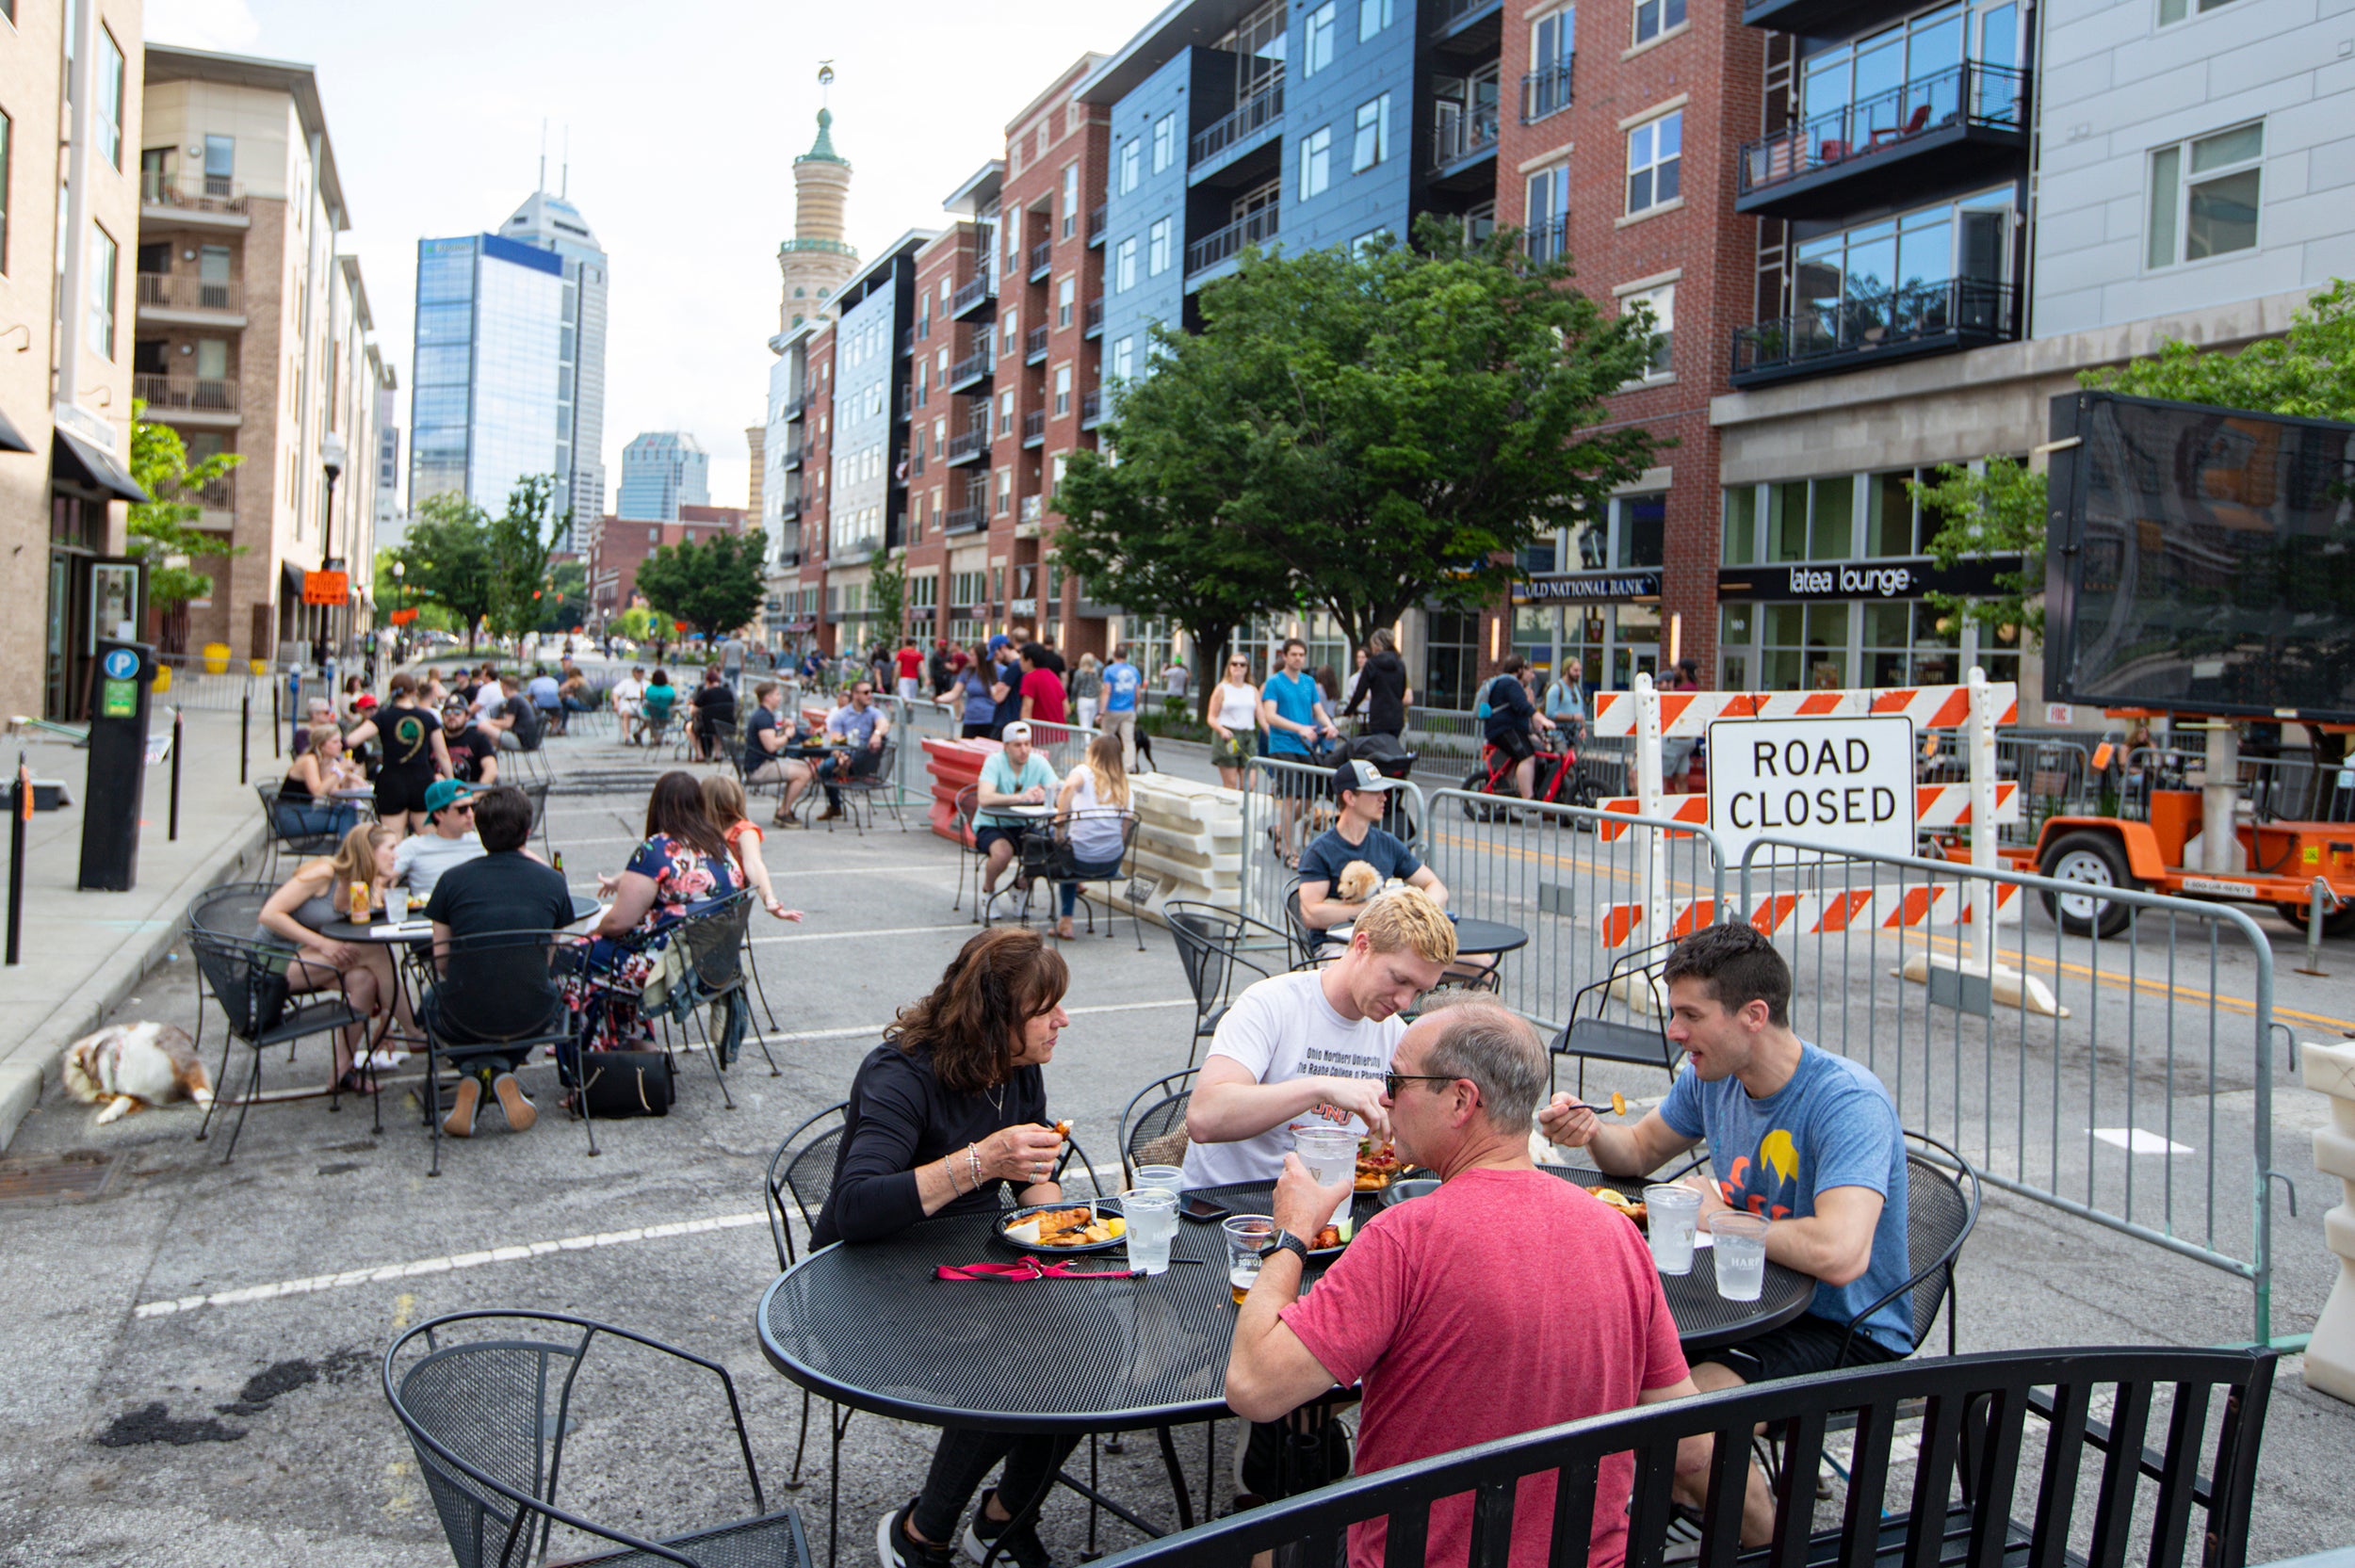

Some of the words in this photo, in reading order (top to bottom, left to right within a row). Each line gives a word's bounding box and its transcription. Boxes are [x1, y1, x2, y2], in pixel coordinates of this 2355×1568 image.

[1525, 581, 1550, 598] OLD
[1551, 580, 1608, 599] NATIONAL
[1609, 578, 1645, 596] BANK
[1790, 567, 1833, 593] latea
[1840, 565, 1910, 597] lounge
[115, 653, 132, 674] P
[1754, 737, 1870, 778] ROAD
[1730, 785, 1895, 829] CLOSED
[1307, 1047, 1323, 1061] Ohio
[1731, 1256, 1761, 1268] HARP
